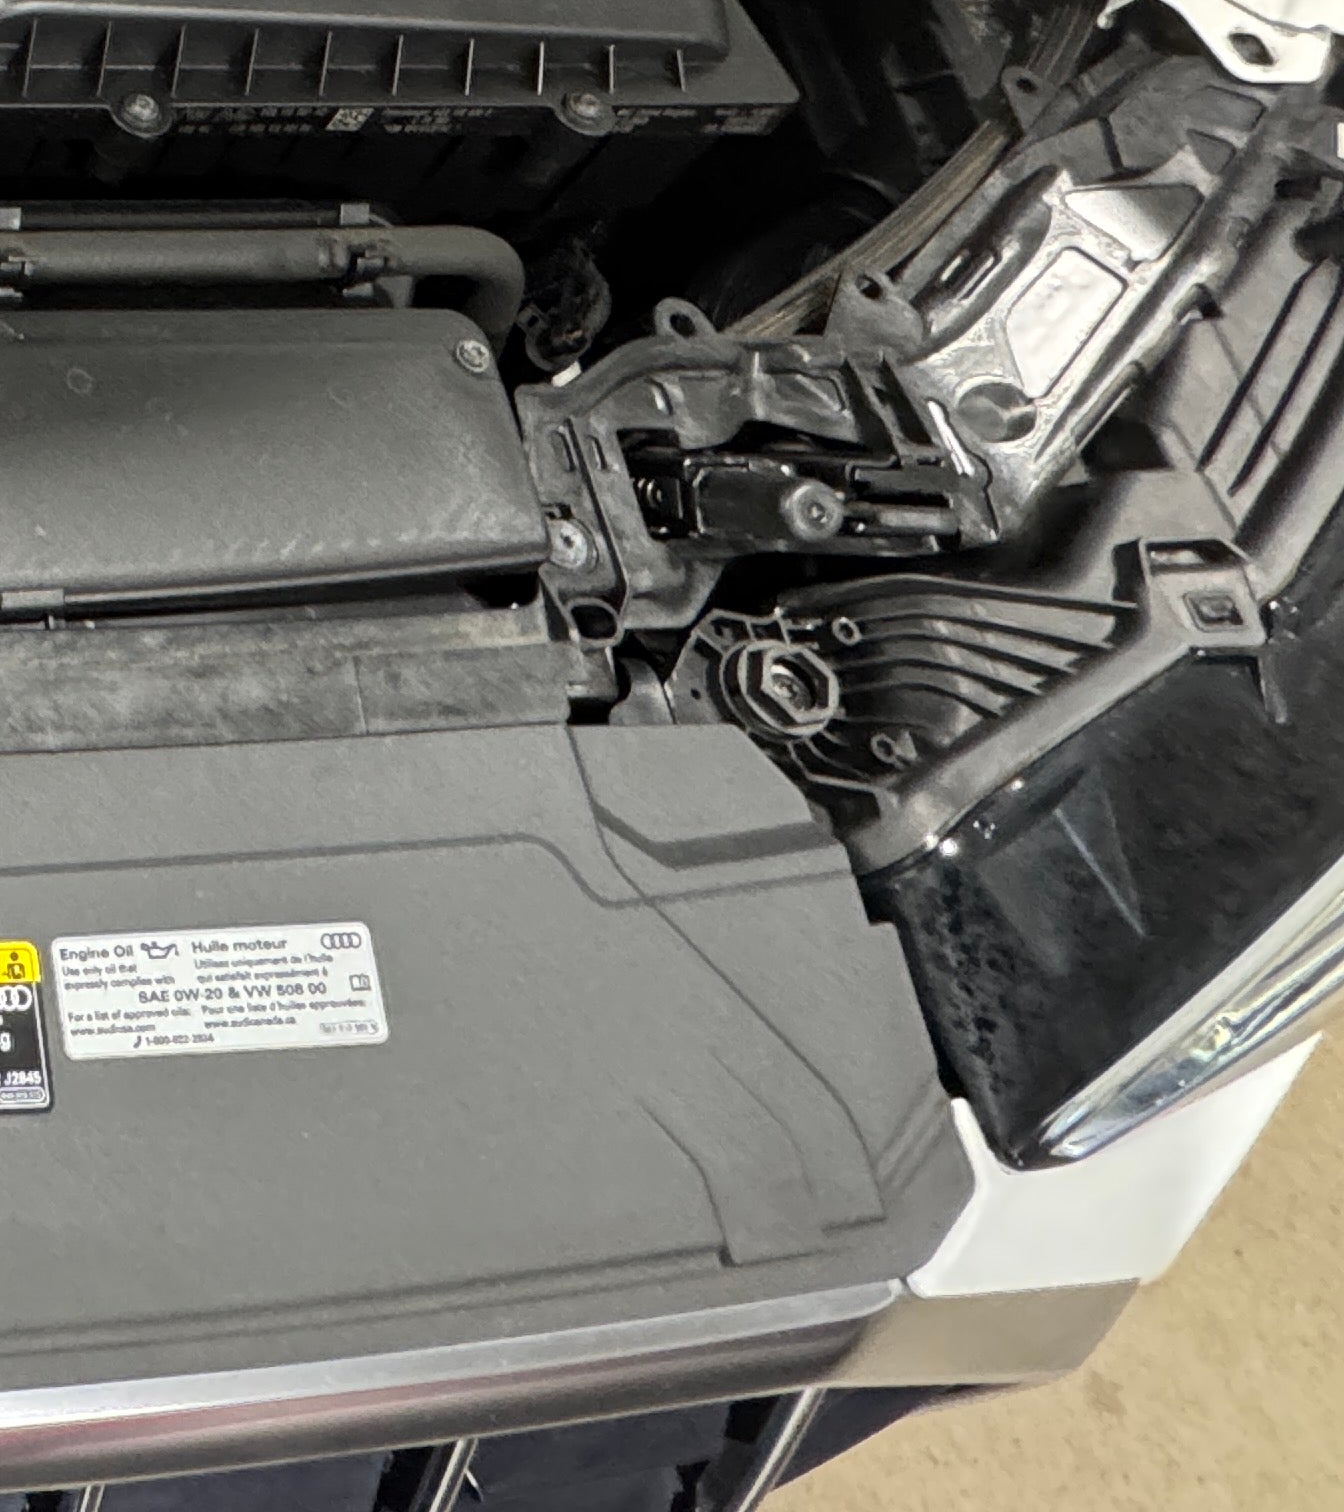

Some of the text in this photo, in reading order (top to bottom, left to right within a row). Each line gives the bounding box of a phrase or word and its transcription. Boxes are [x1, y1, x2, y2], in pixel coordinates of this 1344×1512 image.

[60, 944, 134, 962] Engine Oil
[191, 939, 287, 953] Huile moteur
[138, 990, 170, 1004] SAE
[227, 986, 240, 999] &
[242, 984, 272, 998] VW
[276, 983, 305, 996] 508
[307, 981, 327, 995] 00
